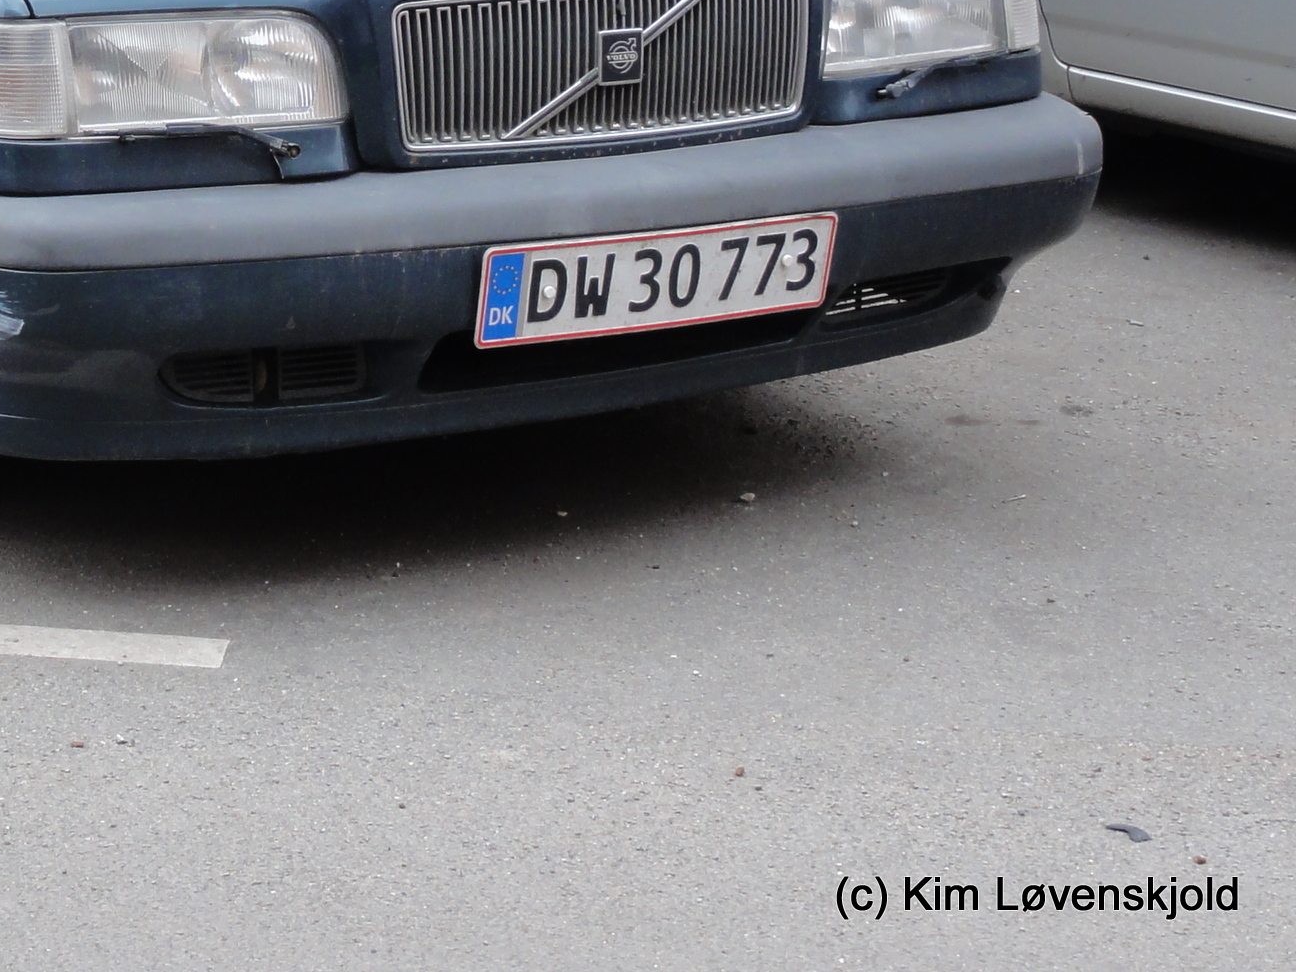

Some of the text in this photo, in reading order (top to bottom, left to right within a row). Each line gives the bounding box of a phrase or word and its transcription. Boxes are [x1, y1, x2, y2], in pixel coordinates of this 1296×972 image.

[527, 229, 818, 323] DW 30 773
[488, 305, 514, 327] DK
